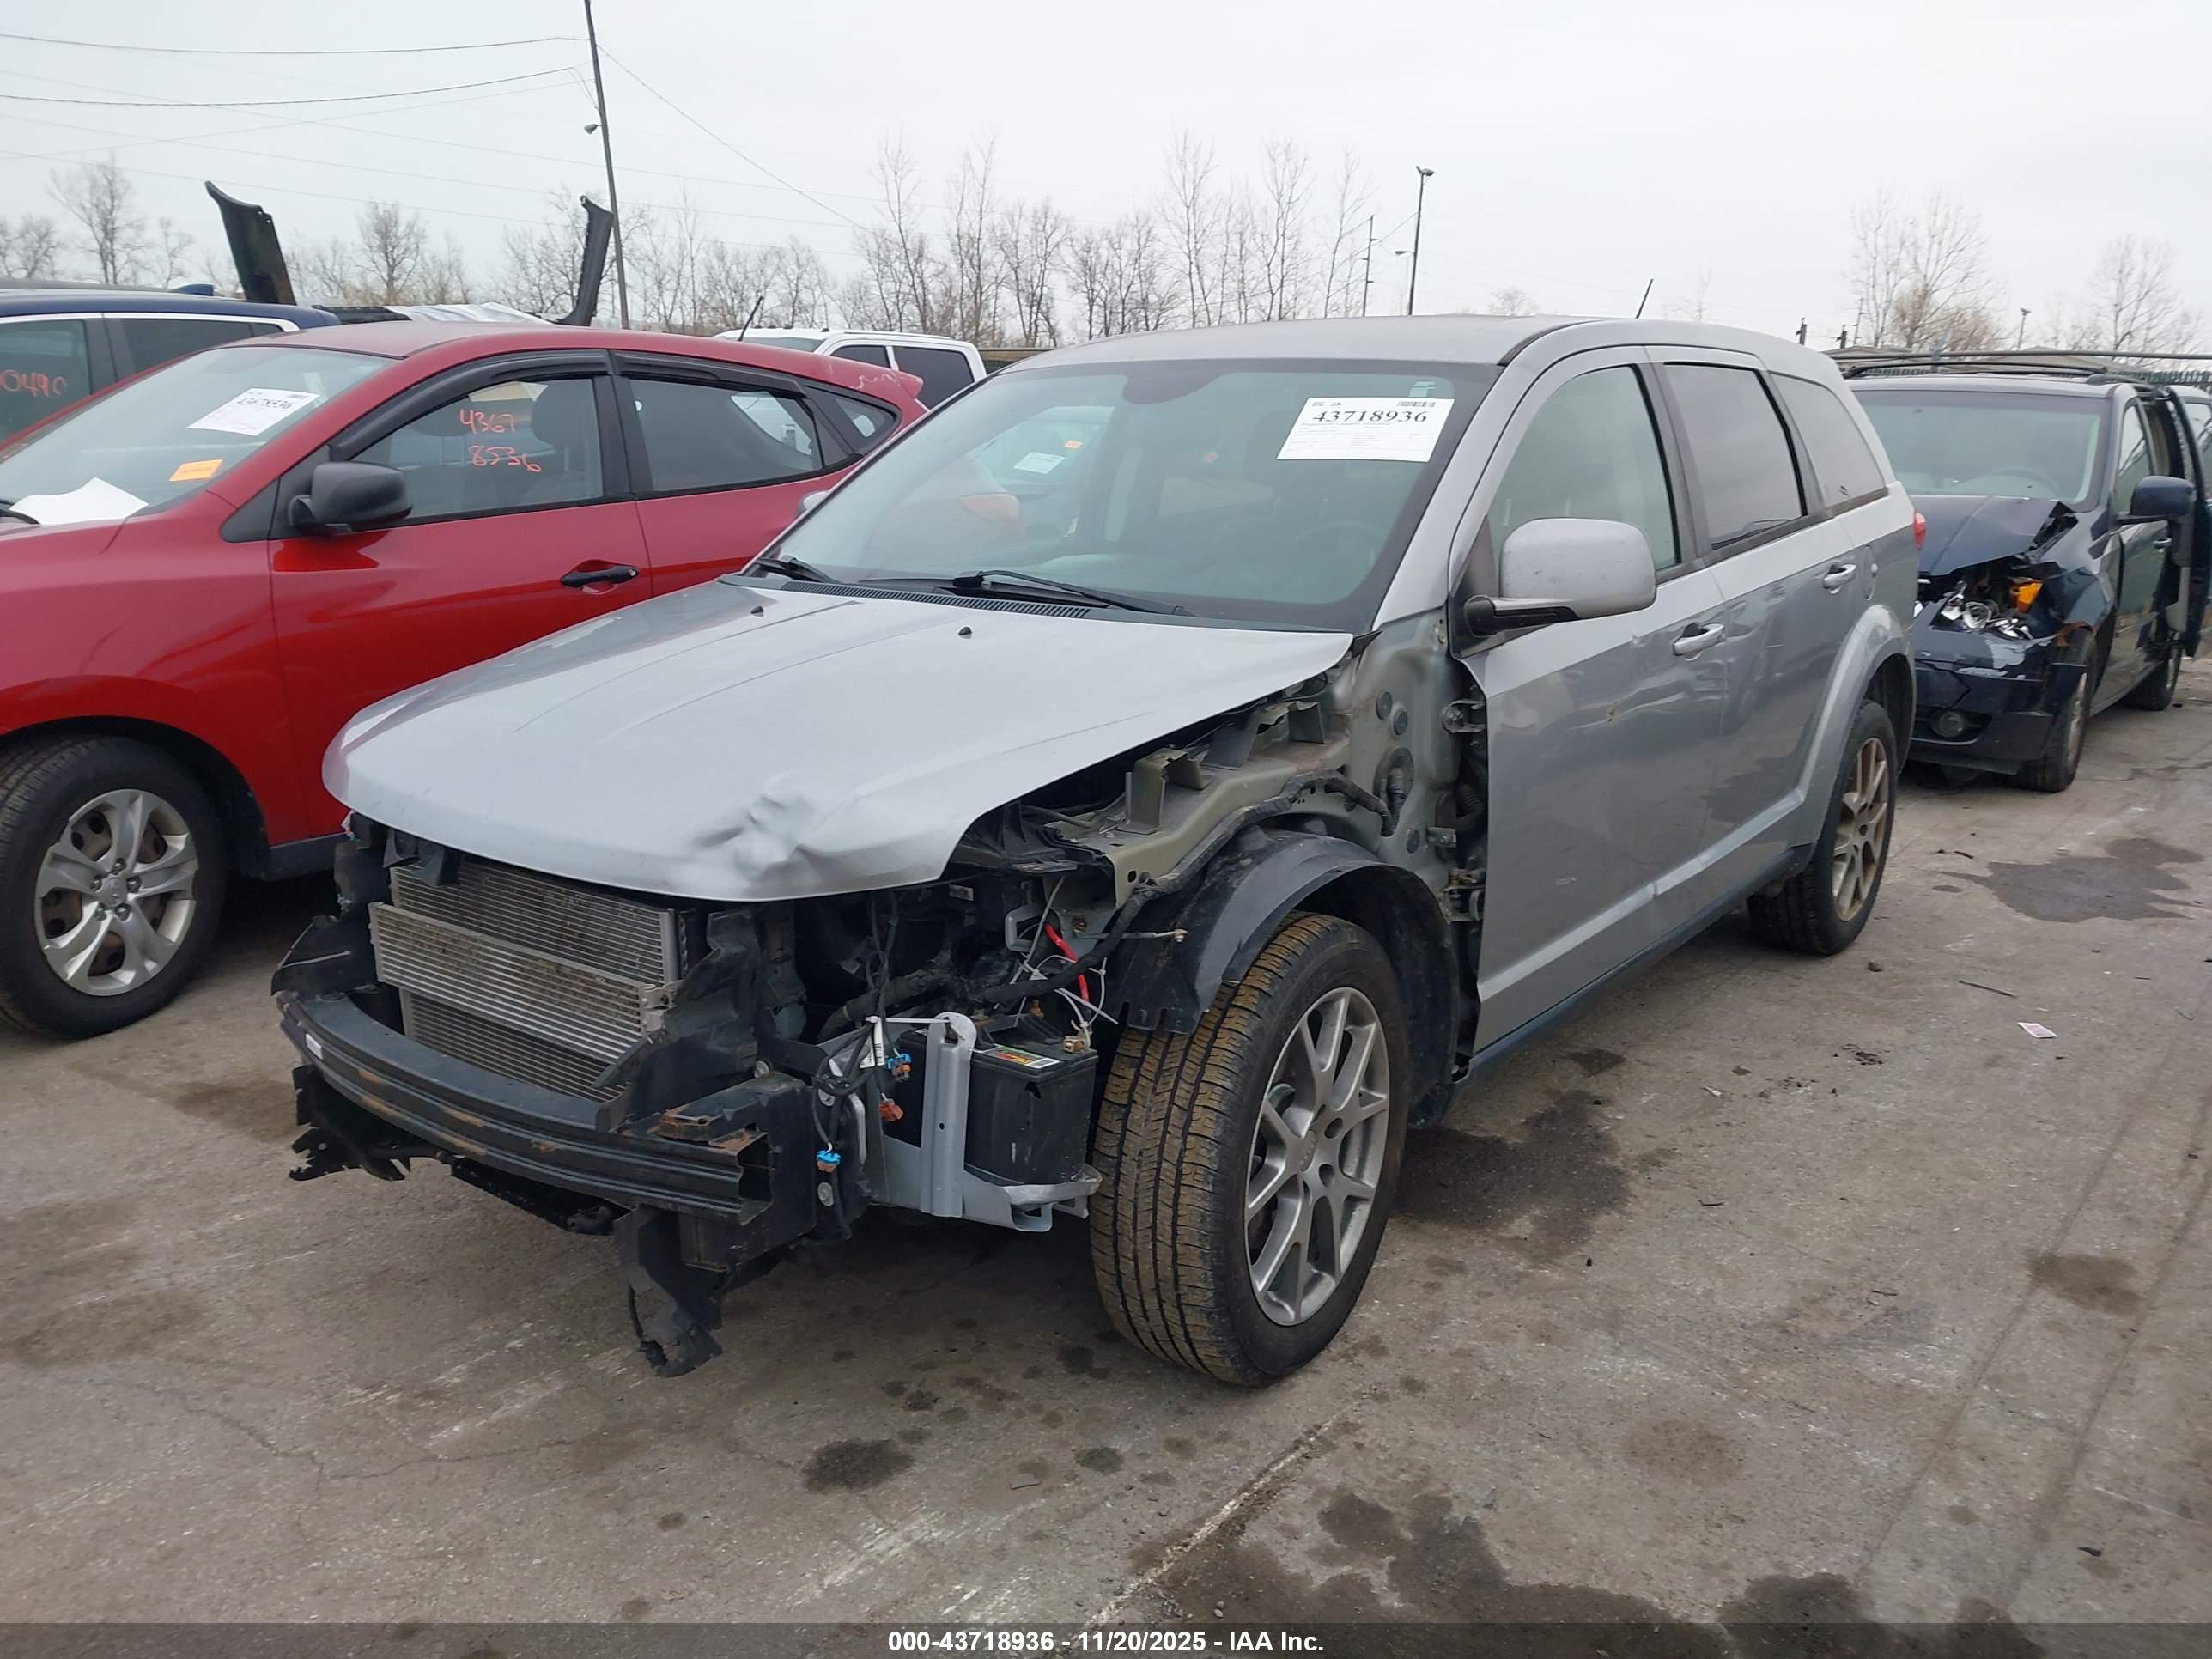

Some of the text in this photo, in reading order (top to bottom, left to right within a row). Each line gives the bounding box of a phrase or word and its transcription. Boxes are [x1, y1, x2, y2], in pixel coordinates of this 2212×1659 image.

[459, 409, 516, 434] 4367
[1313, 410, 1430, 422] 43718936
[468, 445, 542, 472] 8536
